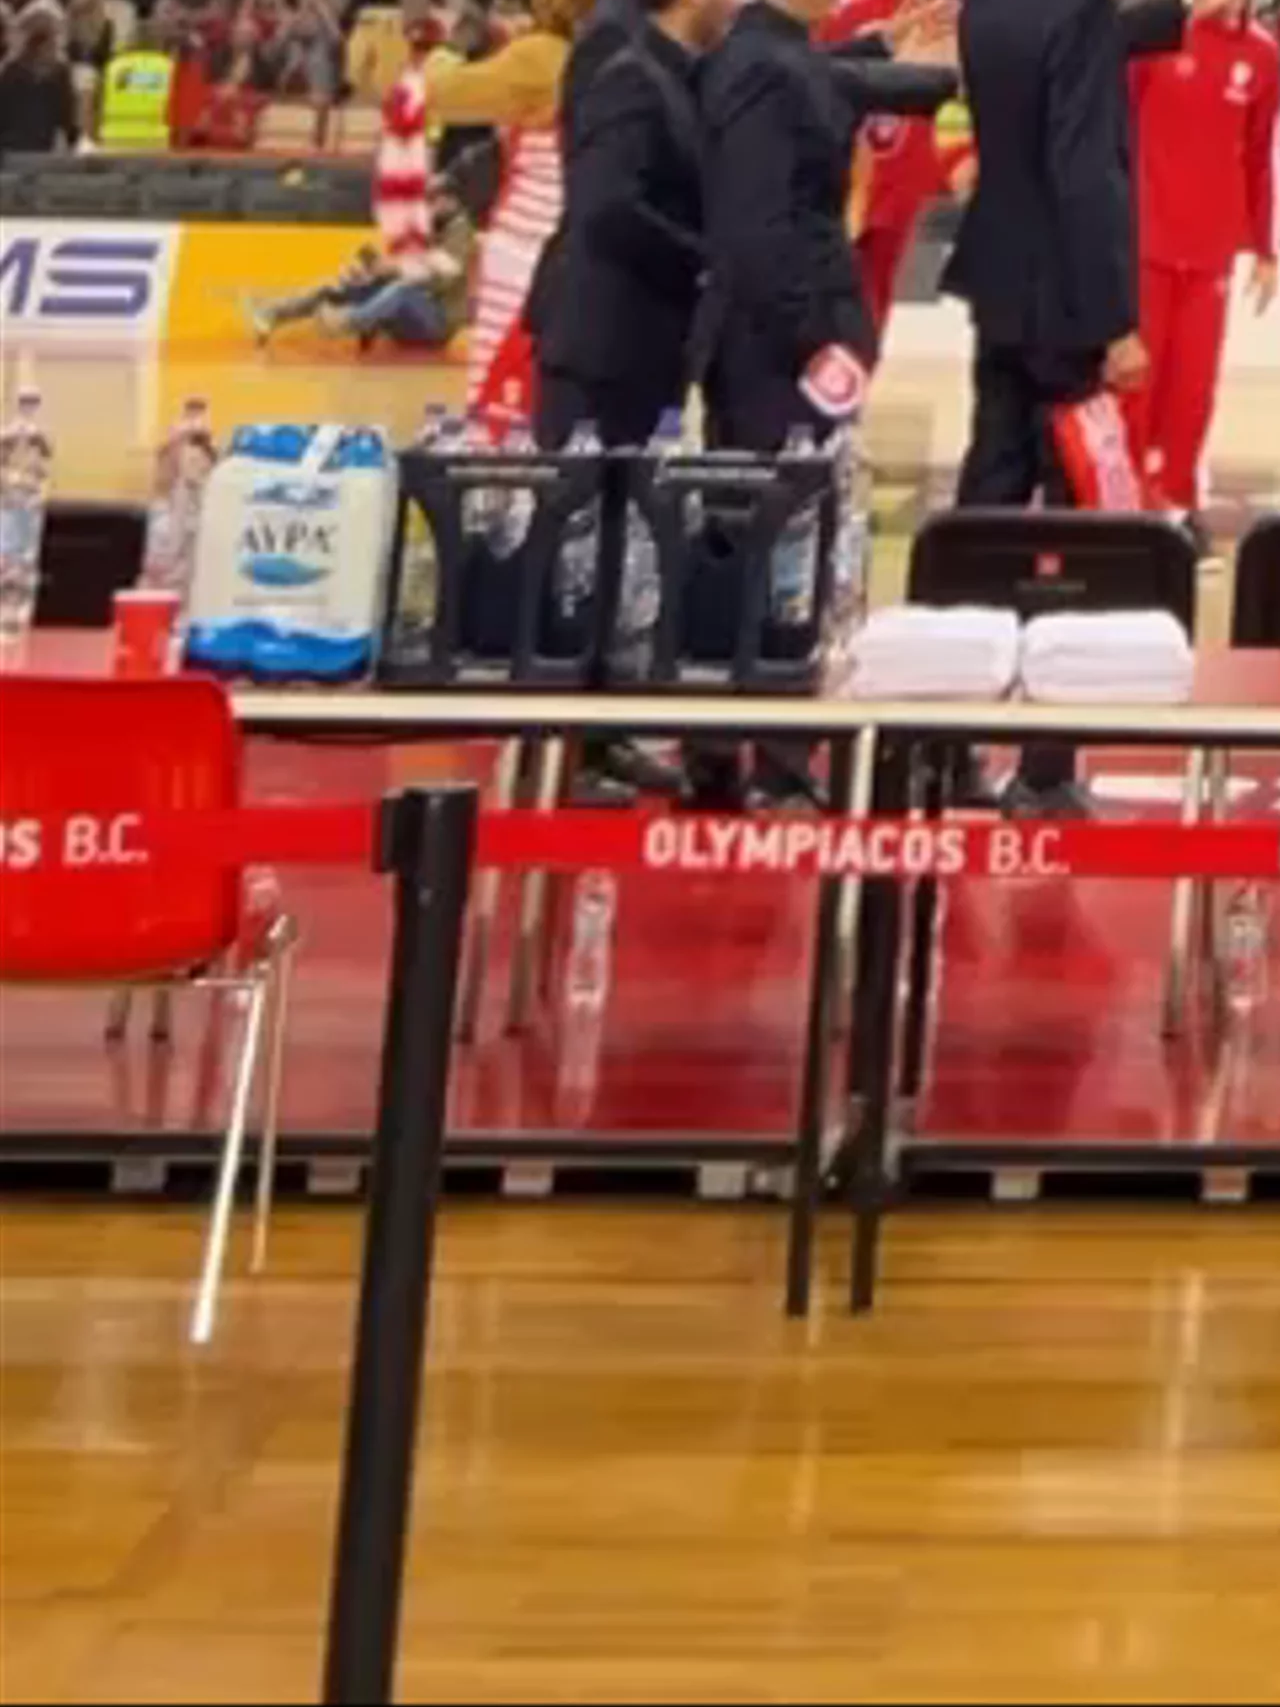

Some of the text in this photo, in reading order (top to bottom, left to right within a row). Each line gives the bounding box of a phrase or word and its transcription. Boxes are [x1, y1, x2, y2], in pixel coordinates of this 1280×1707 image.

[62, 812, 149, 868] B.C.
[643, 819, 1070, 875] OLYMPIACOS B.C.
